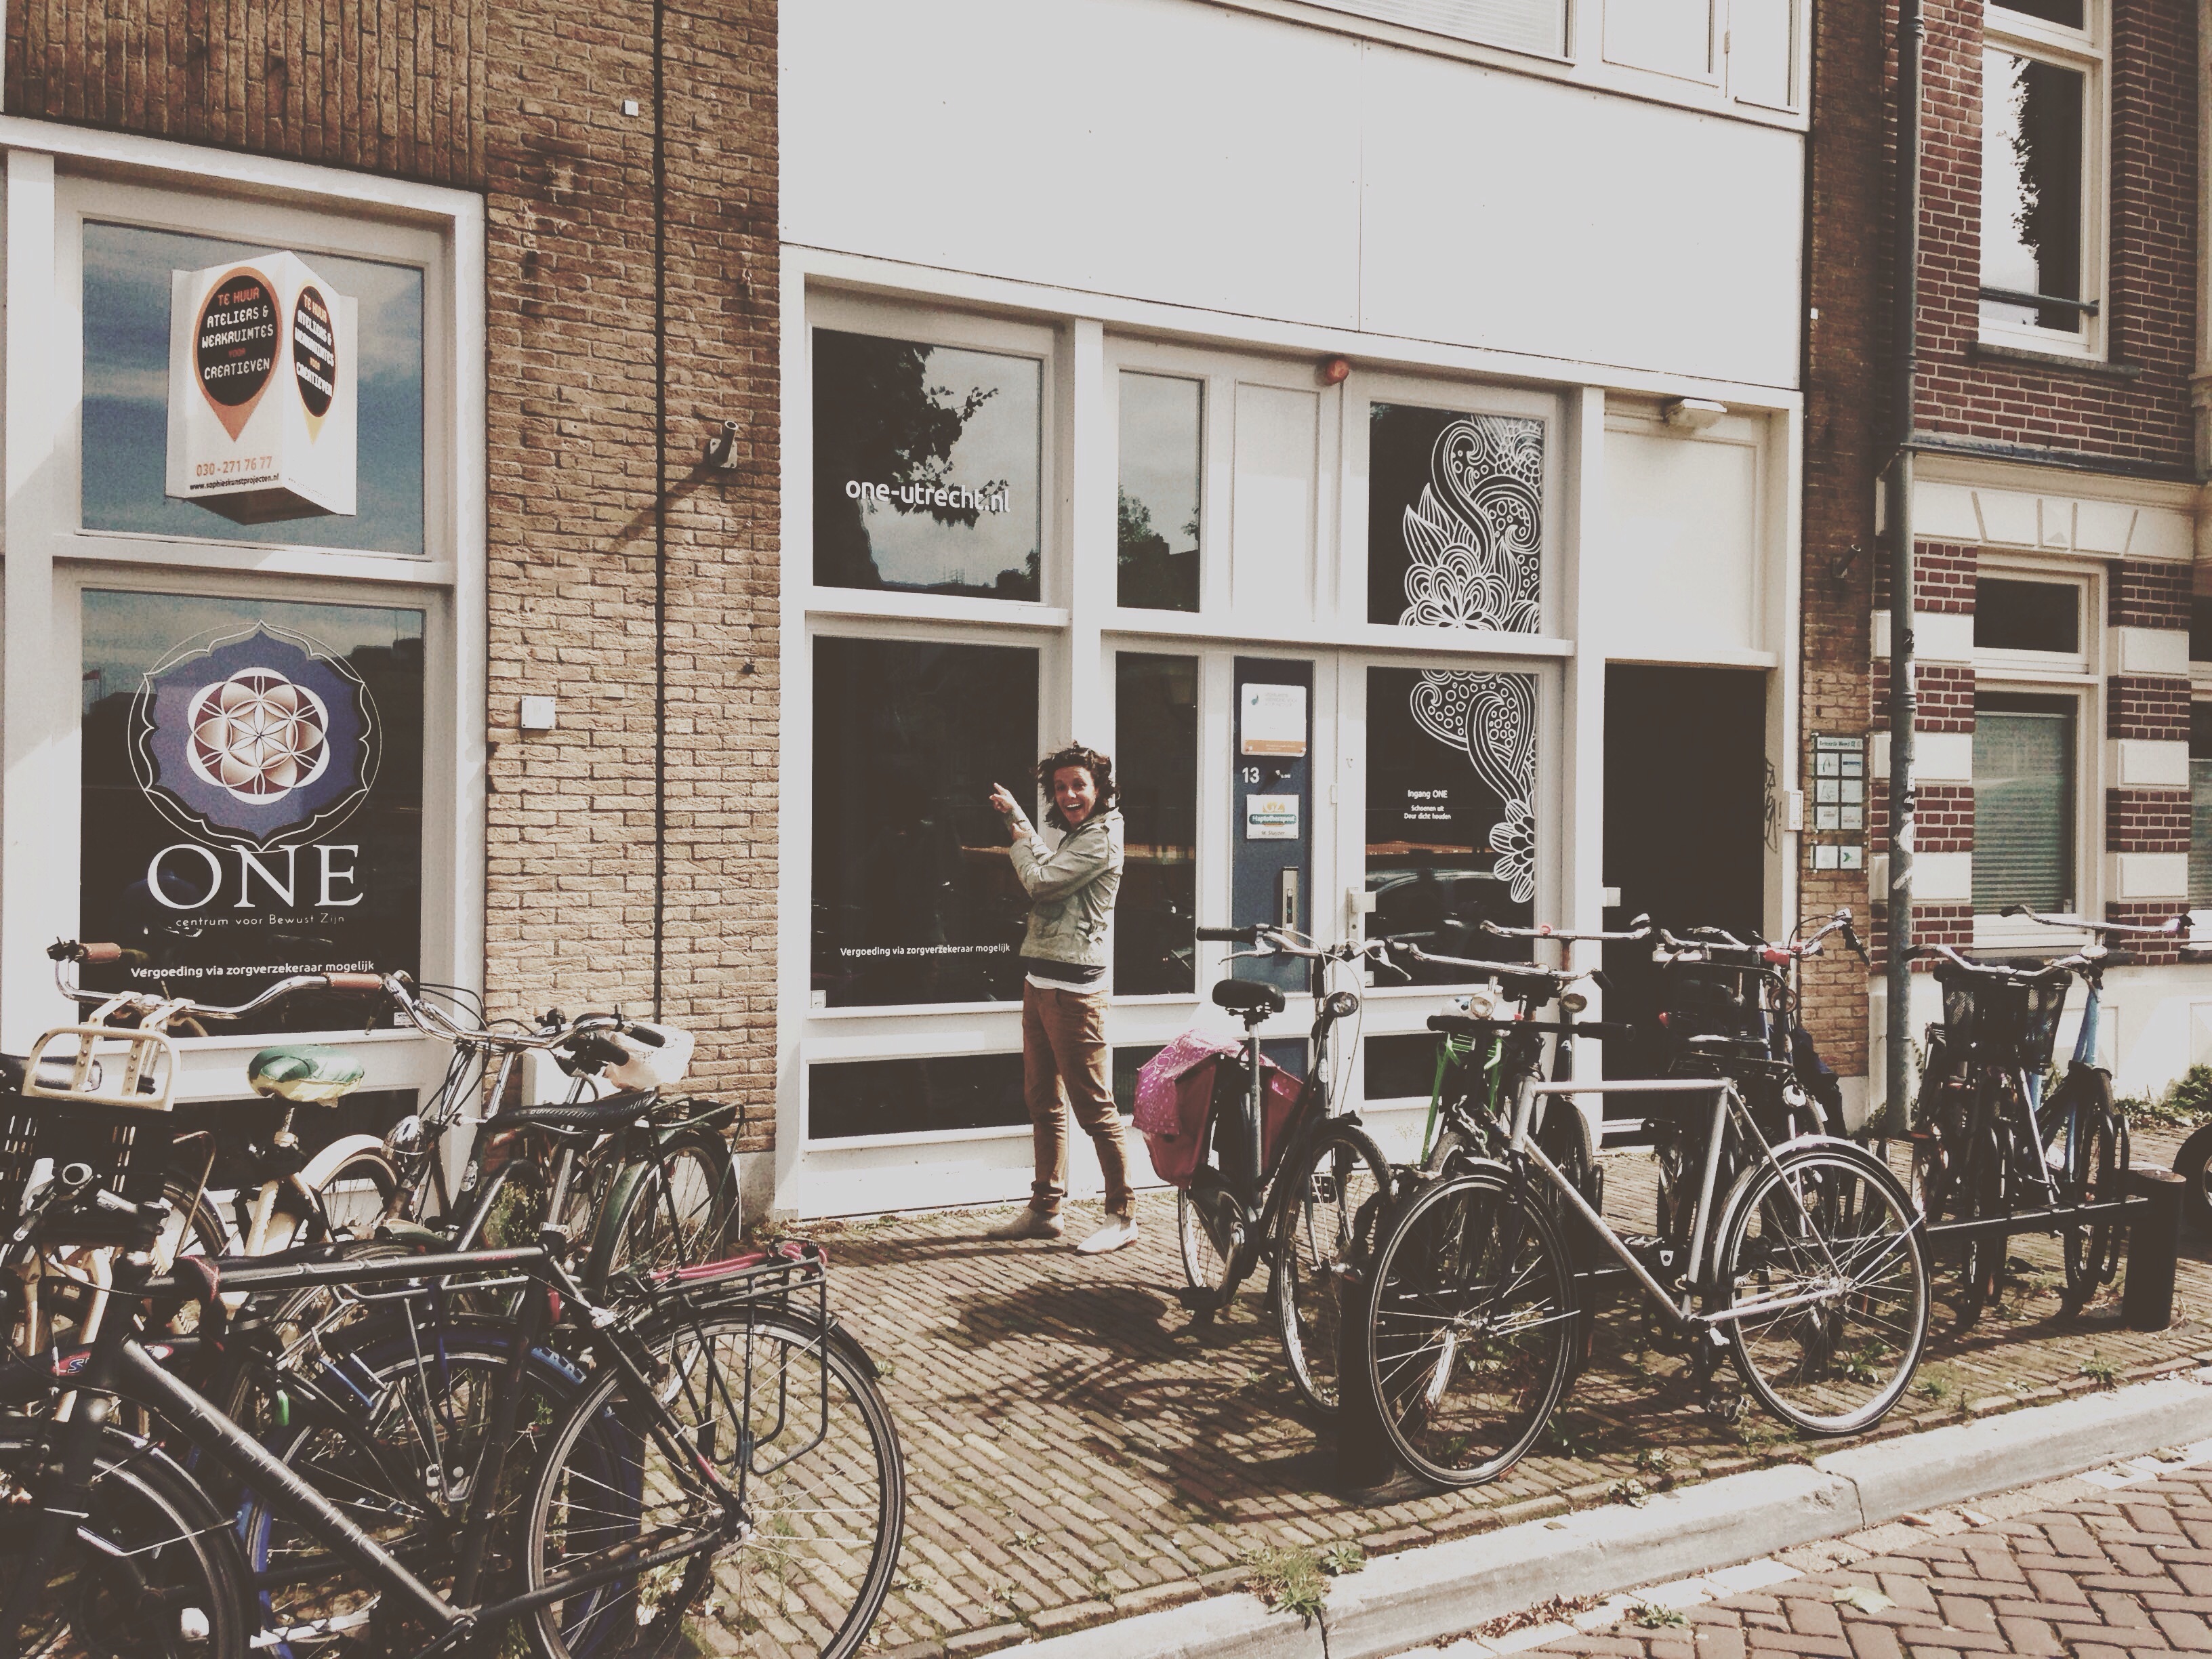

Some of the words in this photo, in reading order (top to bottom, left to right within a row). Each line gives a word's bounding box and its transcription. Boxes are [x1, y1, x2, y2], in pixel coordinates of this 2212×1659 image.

[218, 293, 230, 306] TE
[233, 287, 260, 304] HUUR
[207, 306, 260, 329] ATELIERS
[262, 305, 269, 318] &
[201, 323, 274, 349] WERKRUIMTES
[204, 357, 270, 380] CREATIEVEN
[244, 457, 257, 471] 76
[260, 455, 272, 469] 77
[845, 480, 1010, 512] one-utrecht.nl
[1242, 766, 1261, 783] 13
[1408, 790, 1431, 800] Ingang
[1432, 790, 1448, 798] ONE
[147, 844, 364, 909] ONE
[176, 916, 228, 926] centrum
[235, 916, 263, 926] voor
[269, 914, 314, 925] Bewust
[321, 912, 345, 927] Zijn
[840, 946, 890, 958] Vergoeding
[892, 945, 905, 955] via
[907, 944, 974, 956] zorgverzekeraar
[975, 943, 1010, 954] mogelijk
[131, 965, 203, 979] Vergoeding
[205, 964, 224, 976] via
[226, 962, 323, 977] zorgverzekeraar
[325, 960, 375, 974] mogelijk
